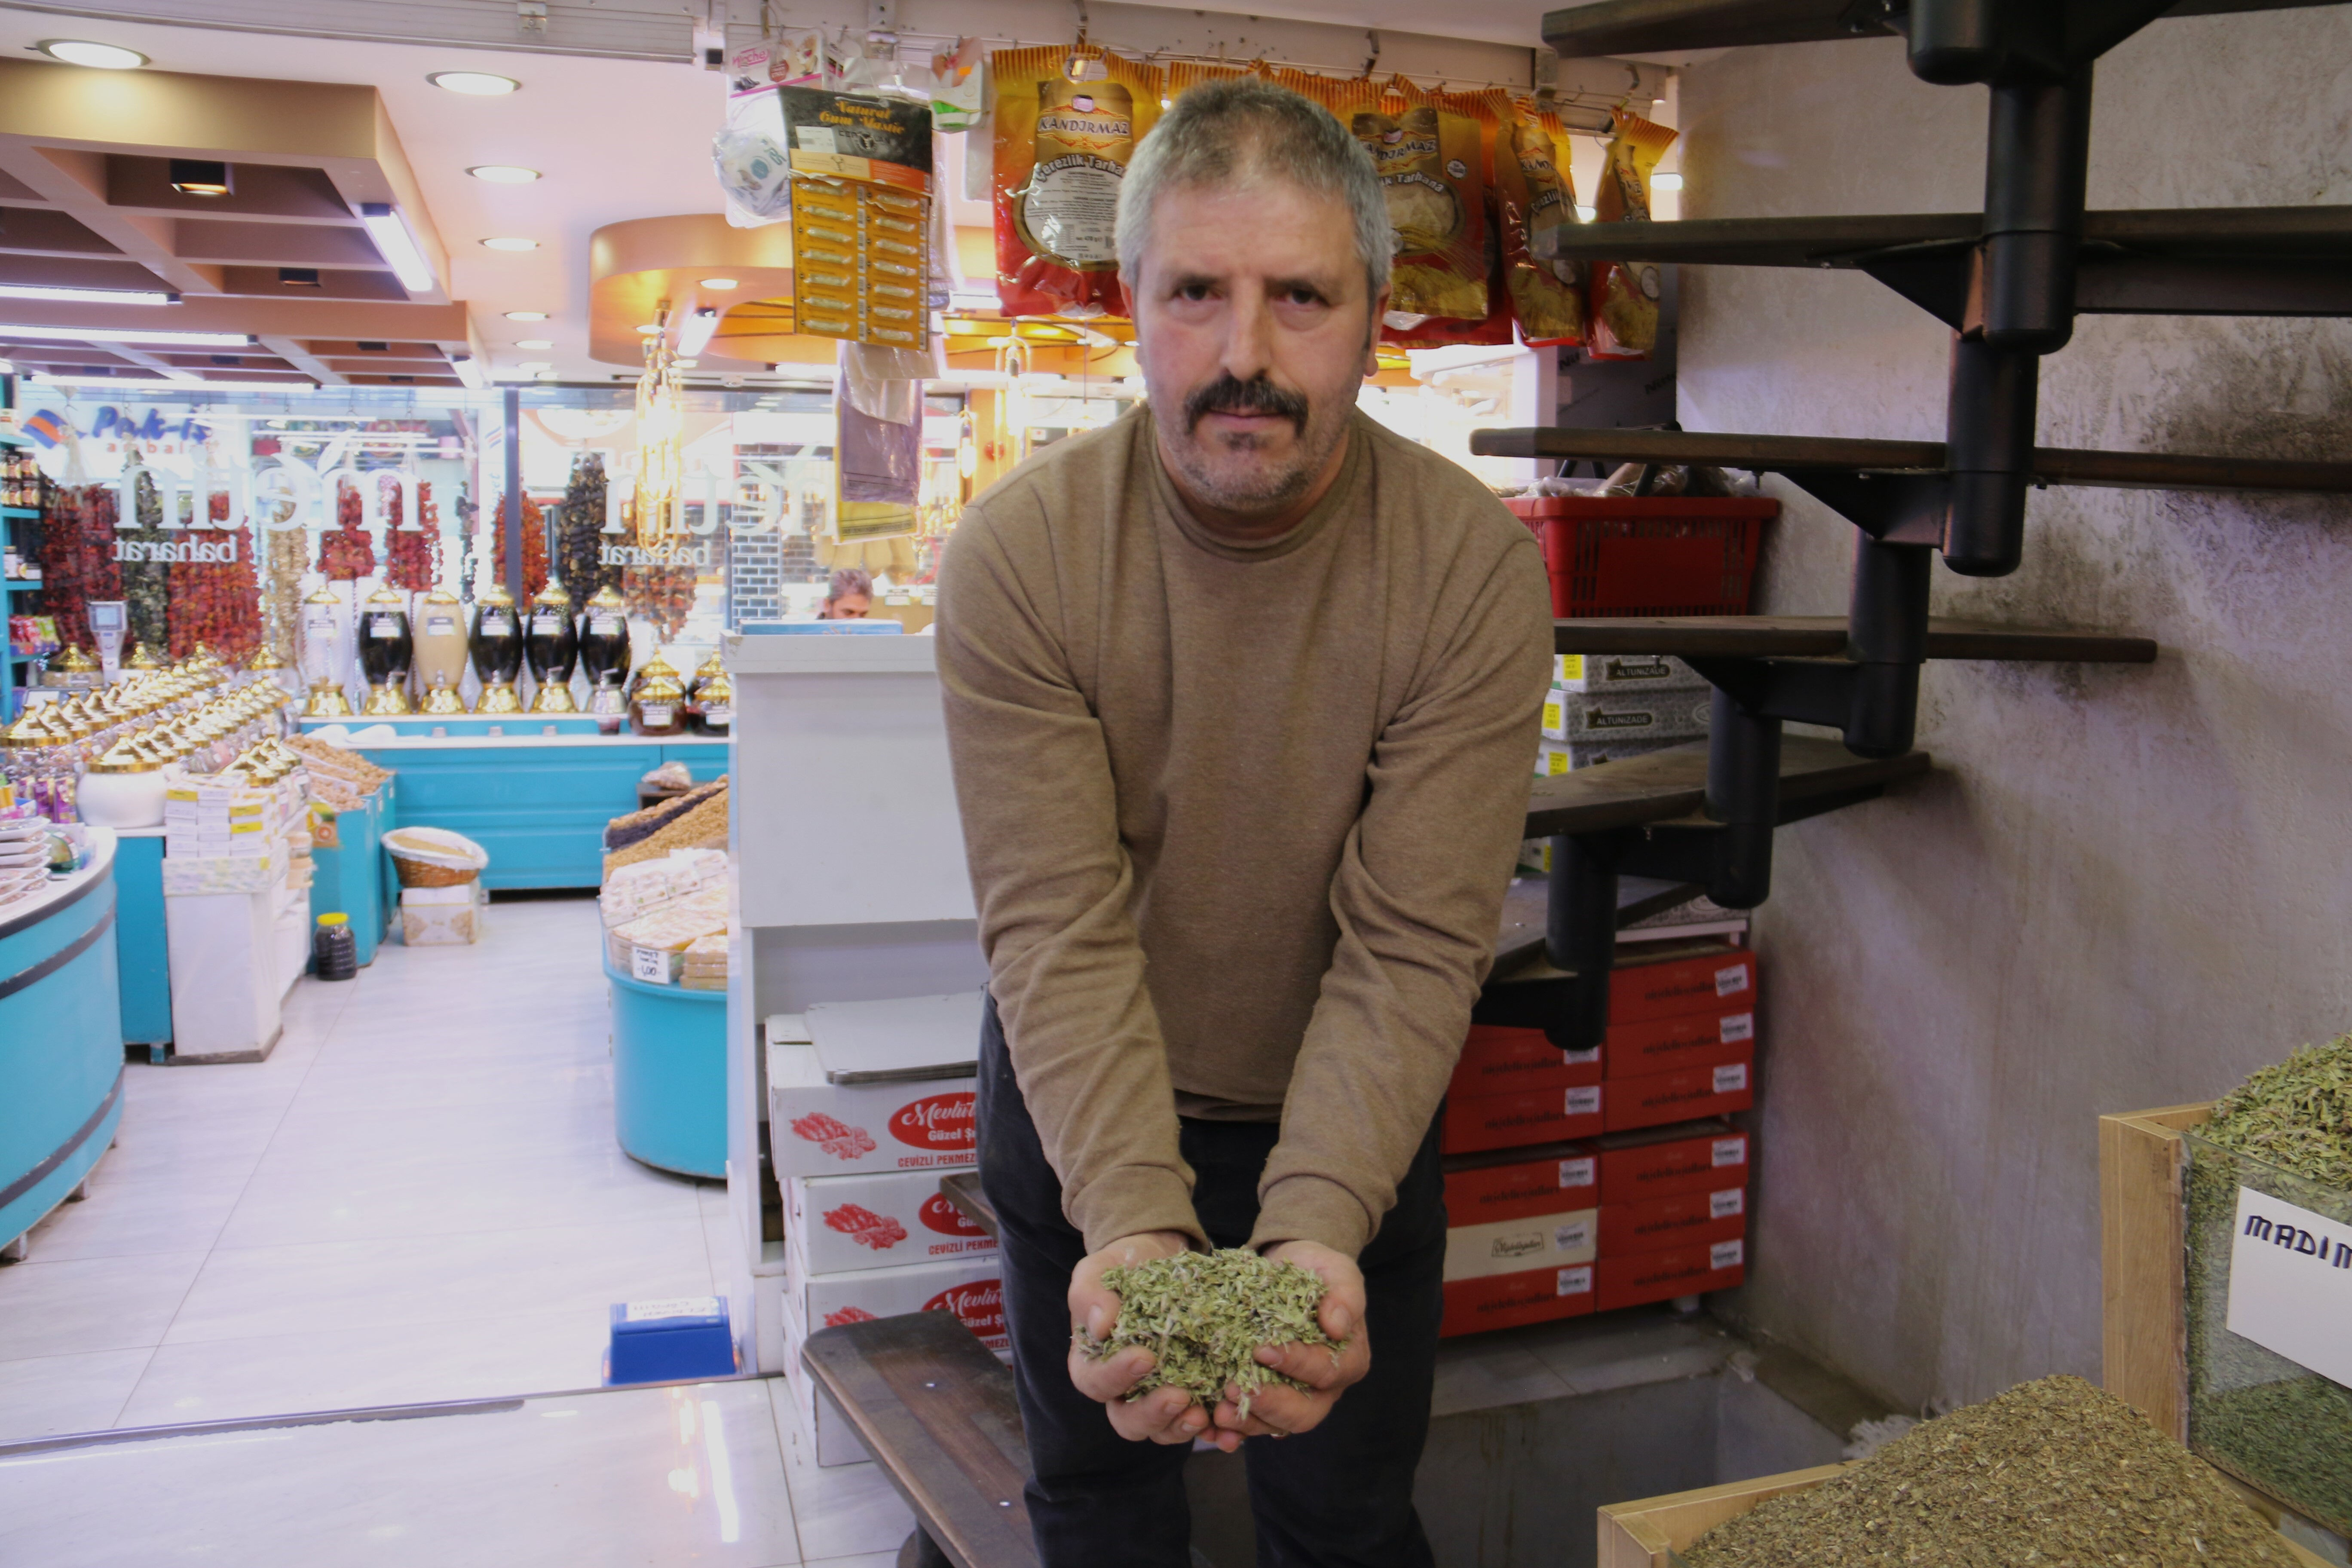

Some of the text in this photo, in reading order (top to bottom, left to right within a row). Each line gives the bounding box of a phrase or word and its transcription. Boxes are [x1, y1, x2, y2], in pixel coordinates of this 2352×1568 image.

[819, 111, 852, 125] Gum
[1087, 155, 1124, 178] Tarha
[1396, 173, 1445, 193] Tarhana
[927, 1127, 976, 1142] Güzel Ş
[897, 1153, 976, 1168] CEVİZLİ PEKMEZ
[928, 1239, 998, 1255] CEVİZLİ PEKME
[932, 1288, 1002, 1317] Mevlü
